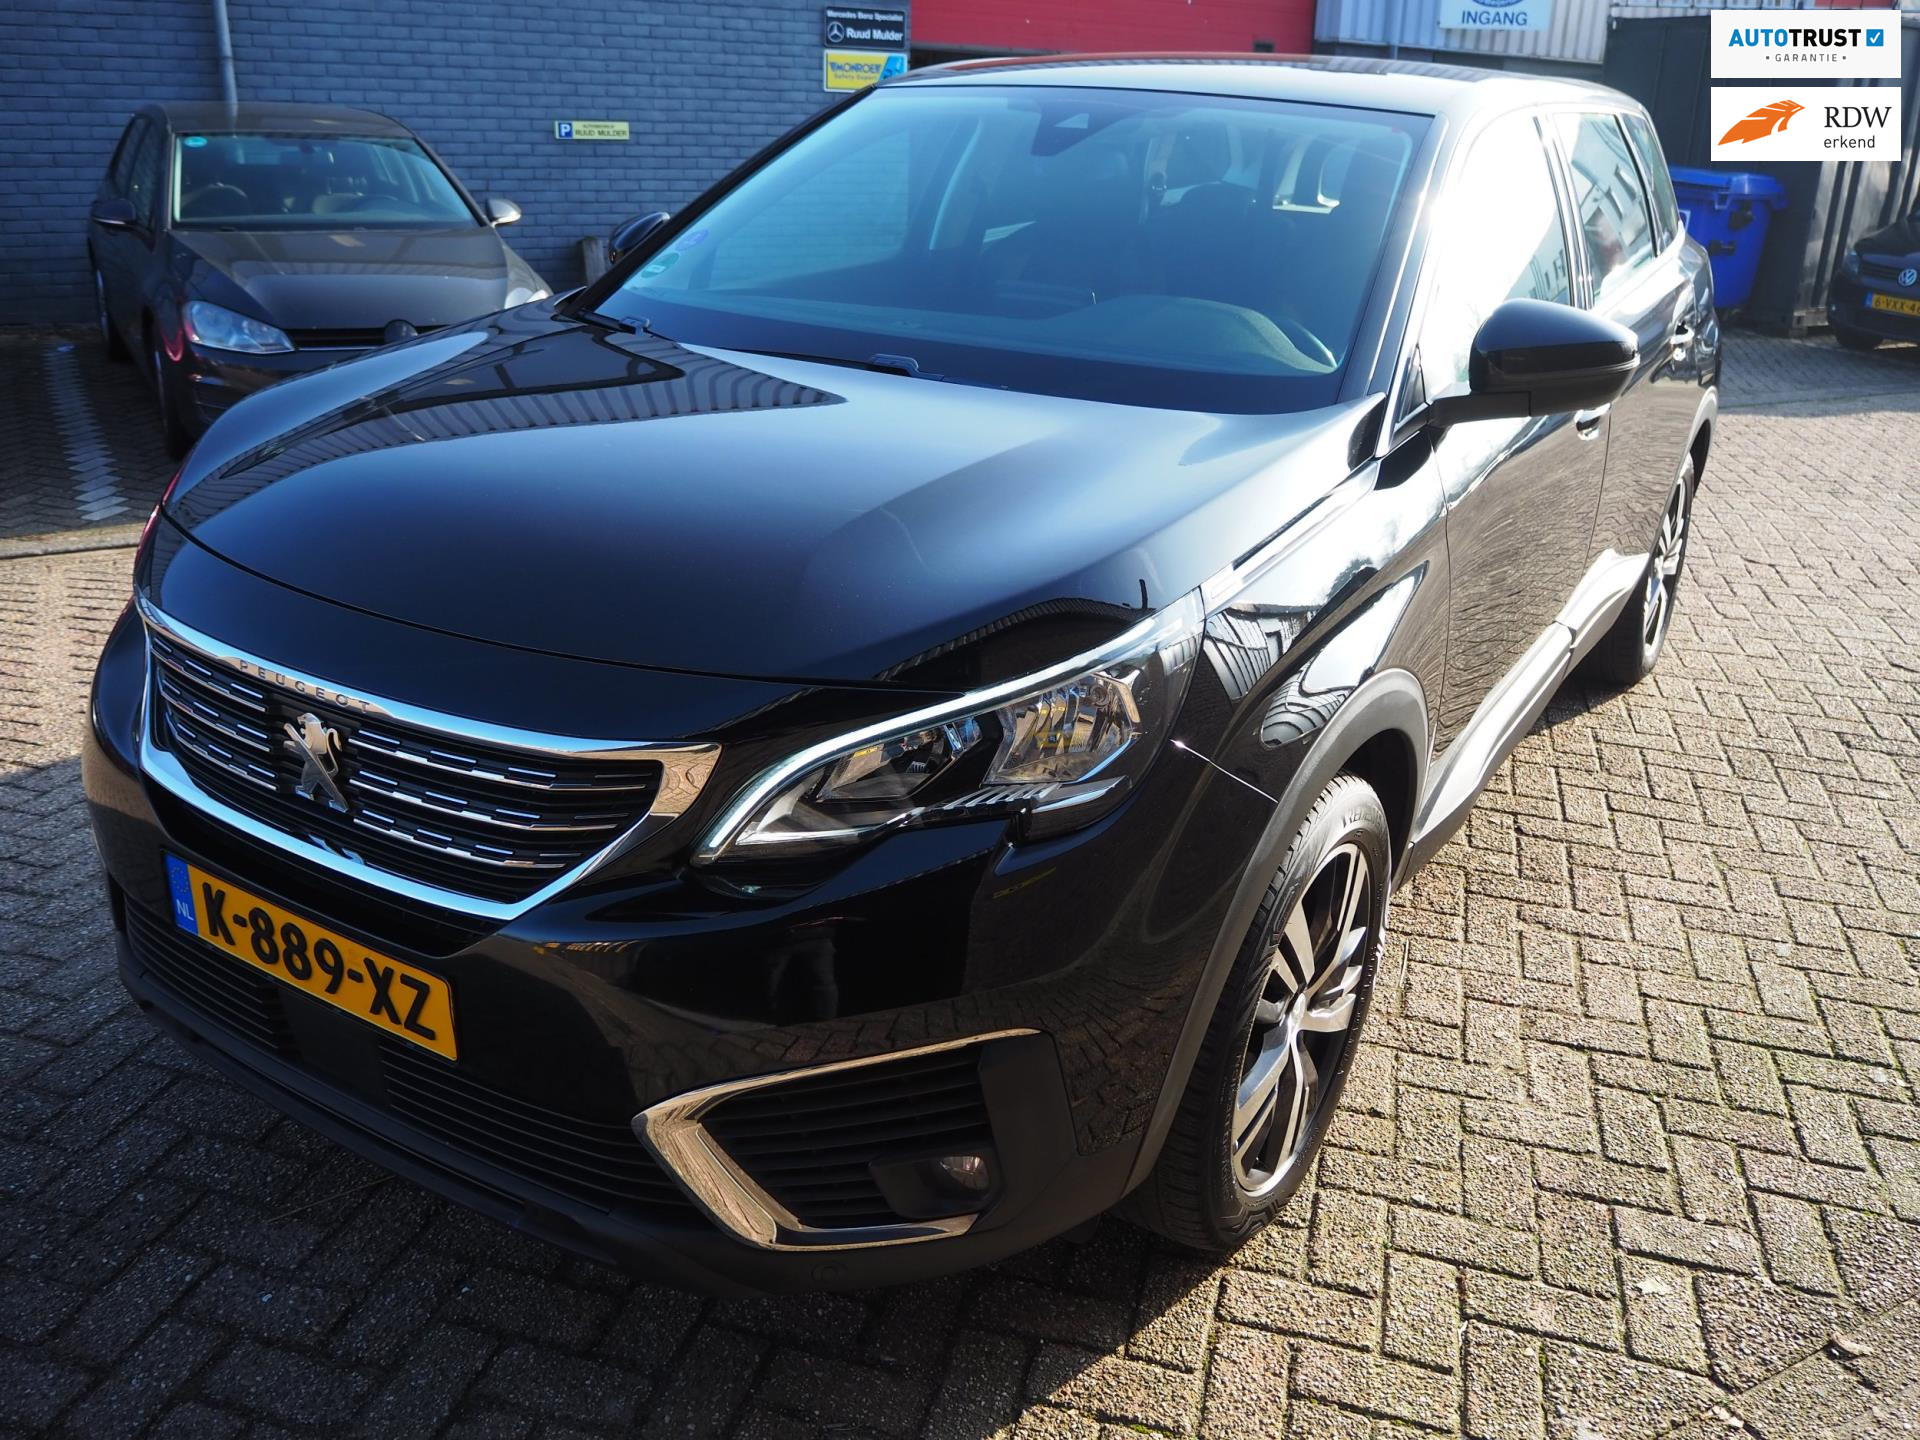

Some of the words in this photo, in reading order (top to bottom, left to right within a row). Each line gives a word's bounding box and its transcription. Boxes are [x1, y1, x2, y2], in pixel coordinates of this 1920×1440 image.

[1461, 10, 1528, 26] INGANG
[846, 27, 871, 39] Ruud
[872, 28, 904, 41] Mulder
[560, 123, 571, 137] P
[597, 129, 627, 137] MULDER
[239, 659, 370, 714] PEUGEOT
[176, 898, 194, 921] NL
[202, 882, 436, 1041] K-889-XZ
